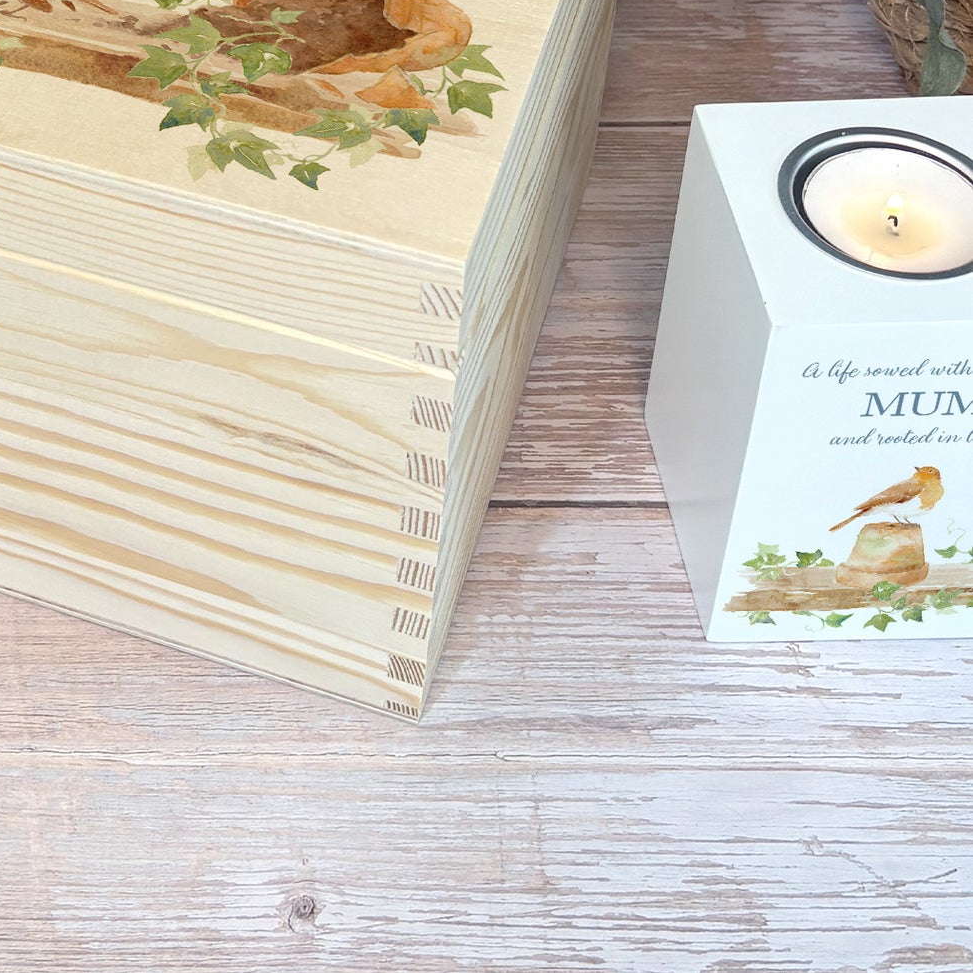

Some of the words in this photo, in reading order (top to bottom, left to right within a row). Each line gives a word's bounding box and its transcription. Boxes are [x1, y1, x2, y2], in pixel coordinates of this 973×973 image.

[801, 361, 823, 379] A
[827, 358, 861, 385] life
[864, 358, 930, 378] sowed
[930, 359, 973, 376] with
[860, 390, 973, 418] MUM
[829, 427, 877, 446] and
[876, 426, 939, 445] rooted
[937, 430, 963, 444] in
